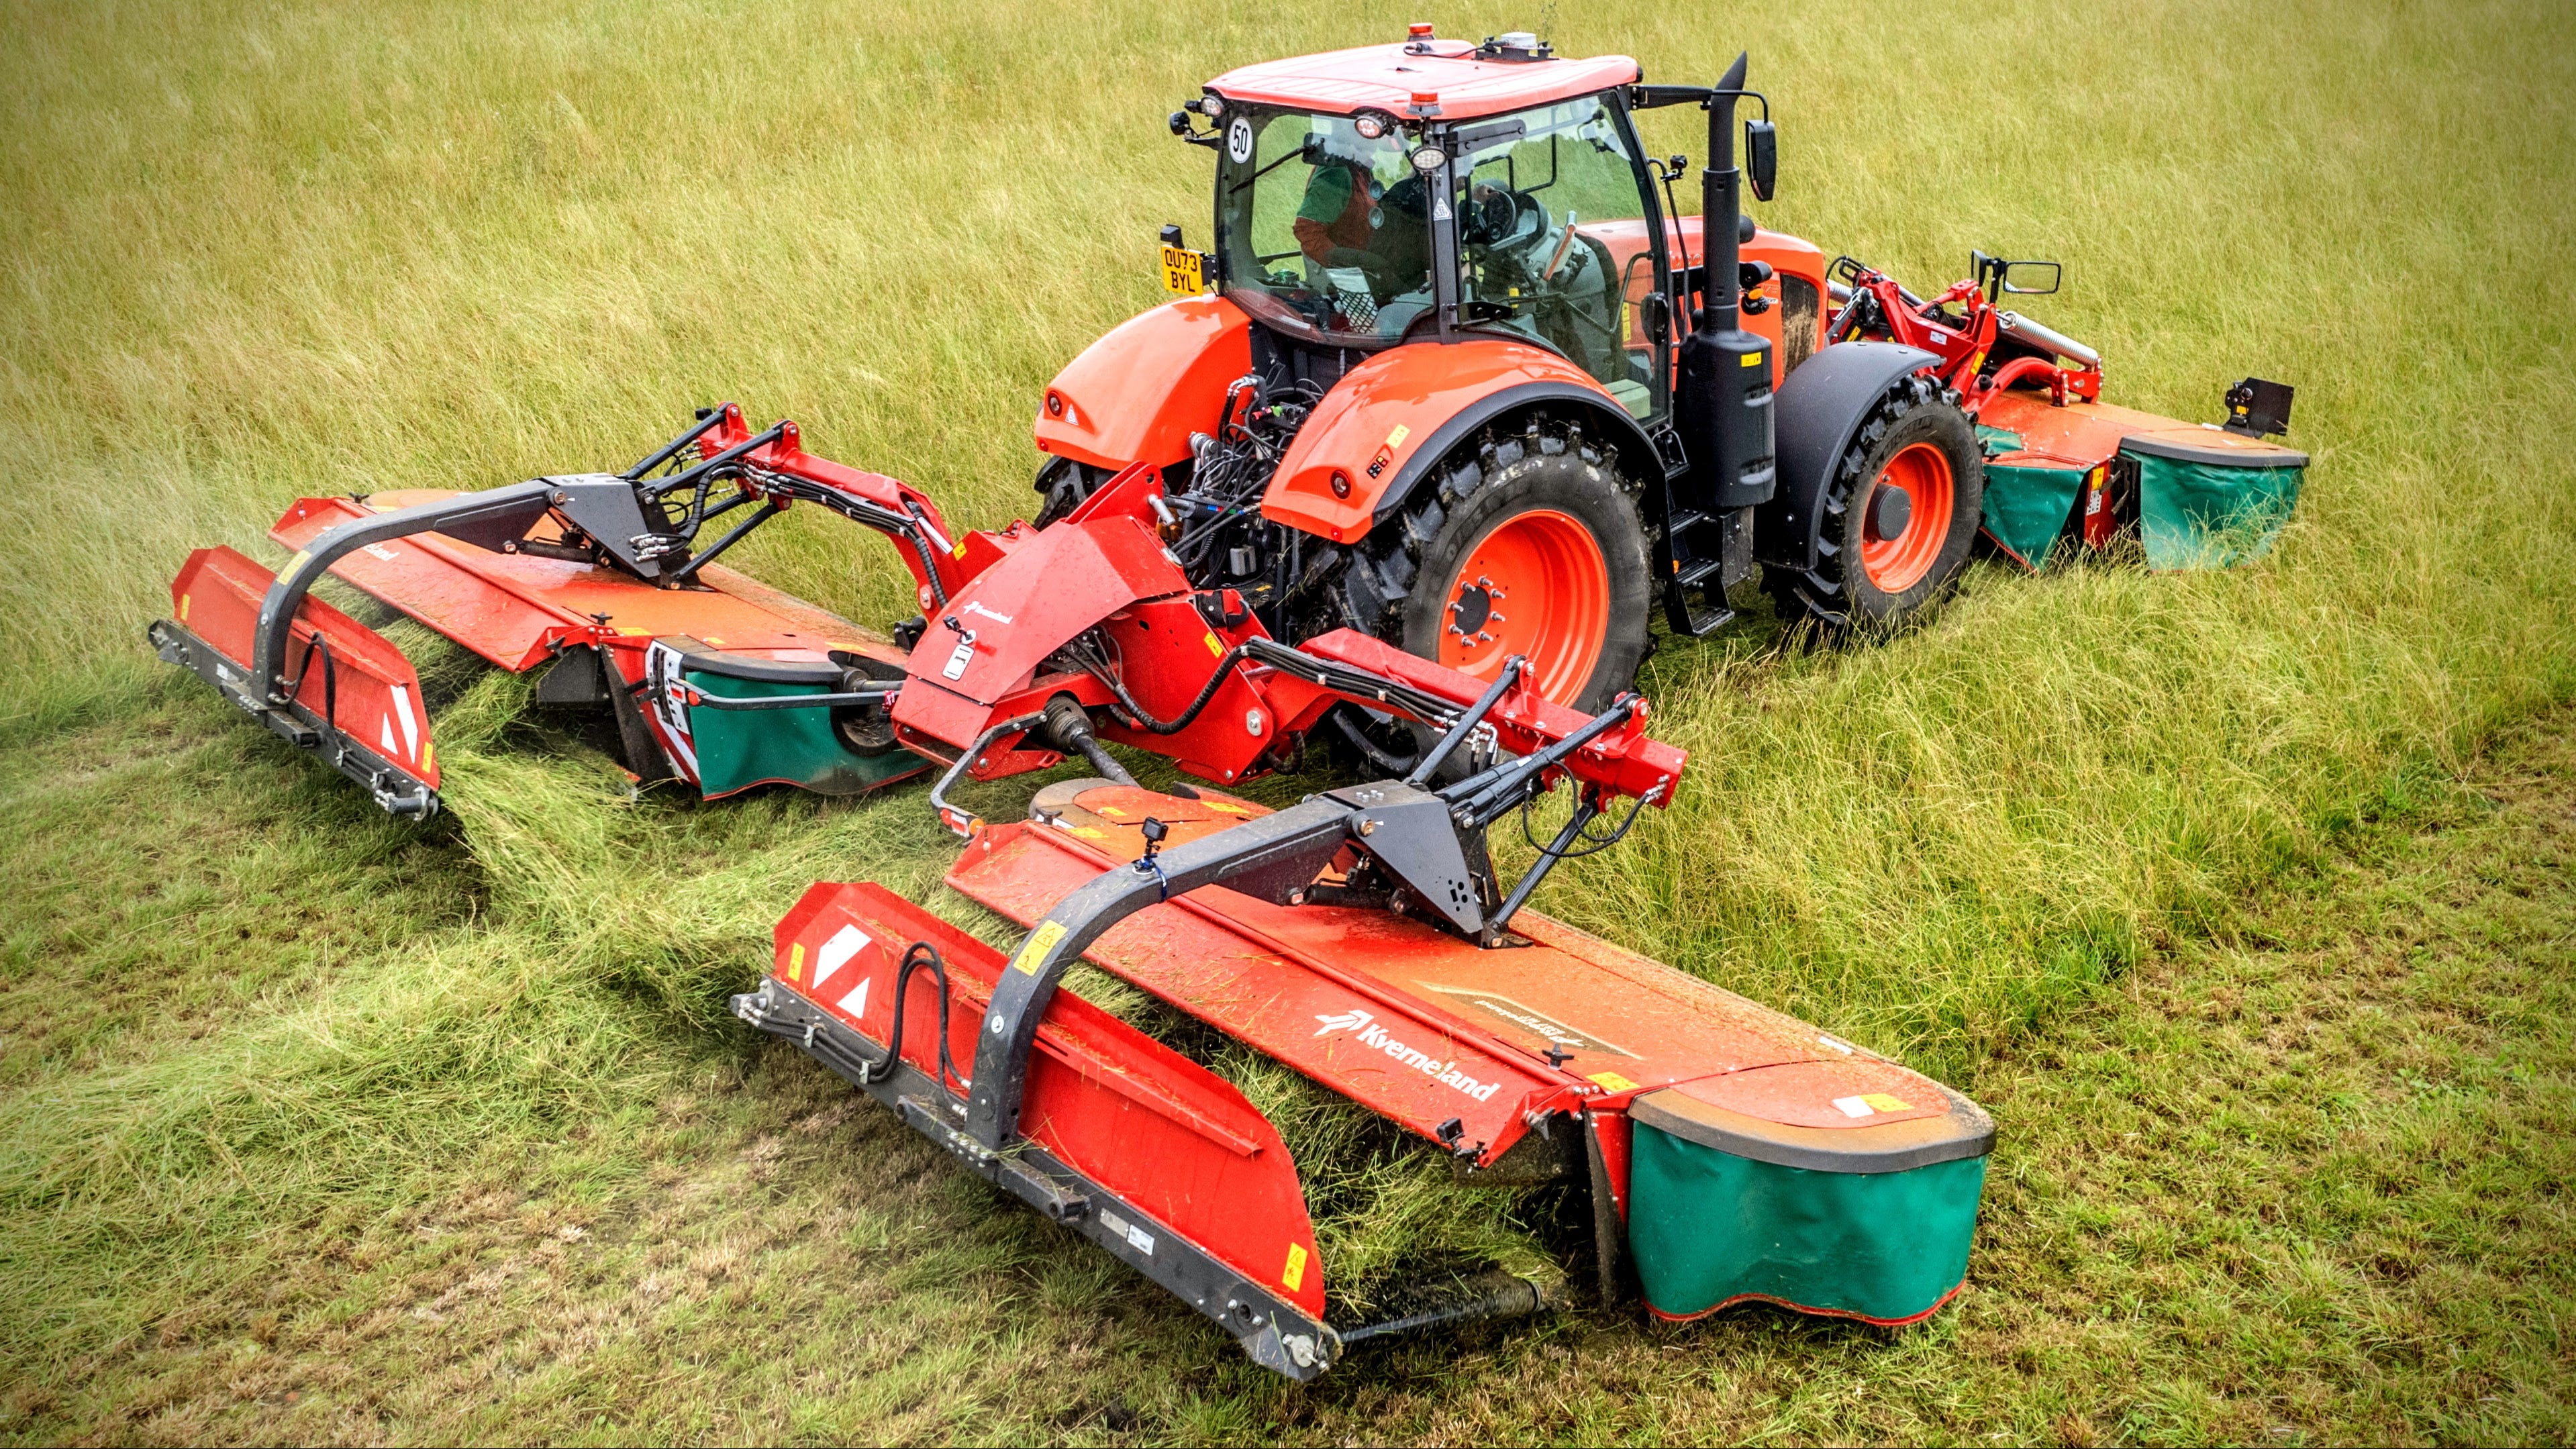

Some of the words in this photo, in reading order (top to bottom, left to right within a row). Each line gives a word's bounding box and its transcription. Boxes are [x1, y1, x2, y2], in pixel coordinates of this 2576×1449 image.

[1233, 123, 1248, 155] 50
[1165, 249, 1197, 272] OU73
[1171, 270, 1195, 293] BYL
[1356, 1023, 1501, 1103] Kverneland
